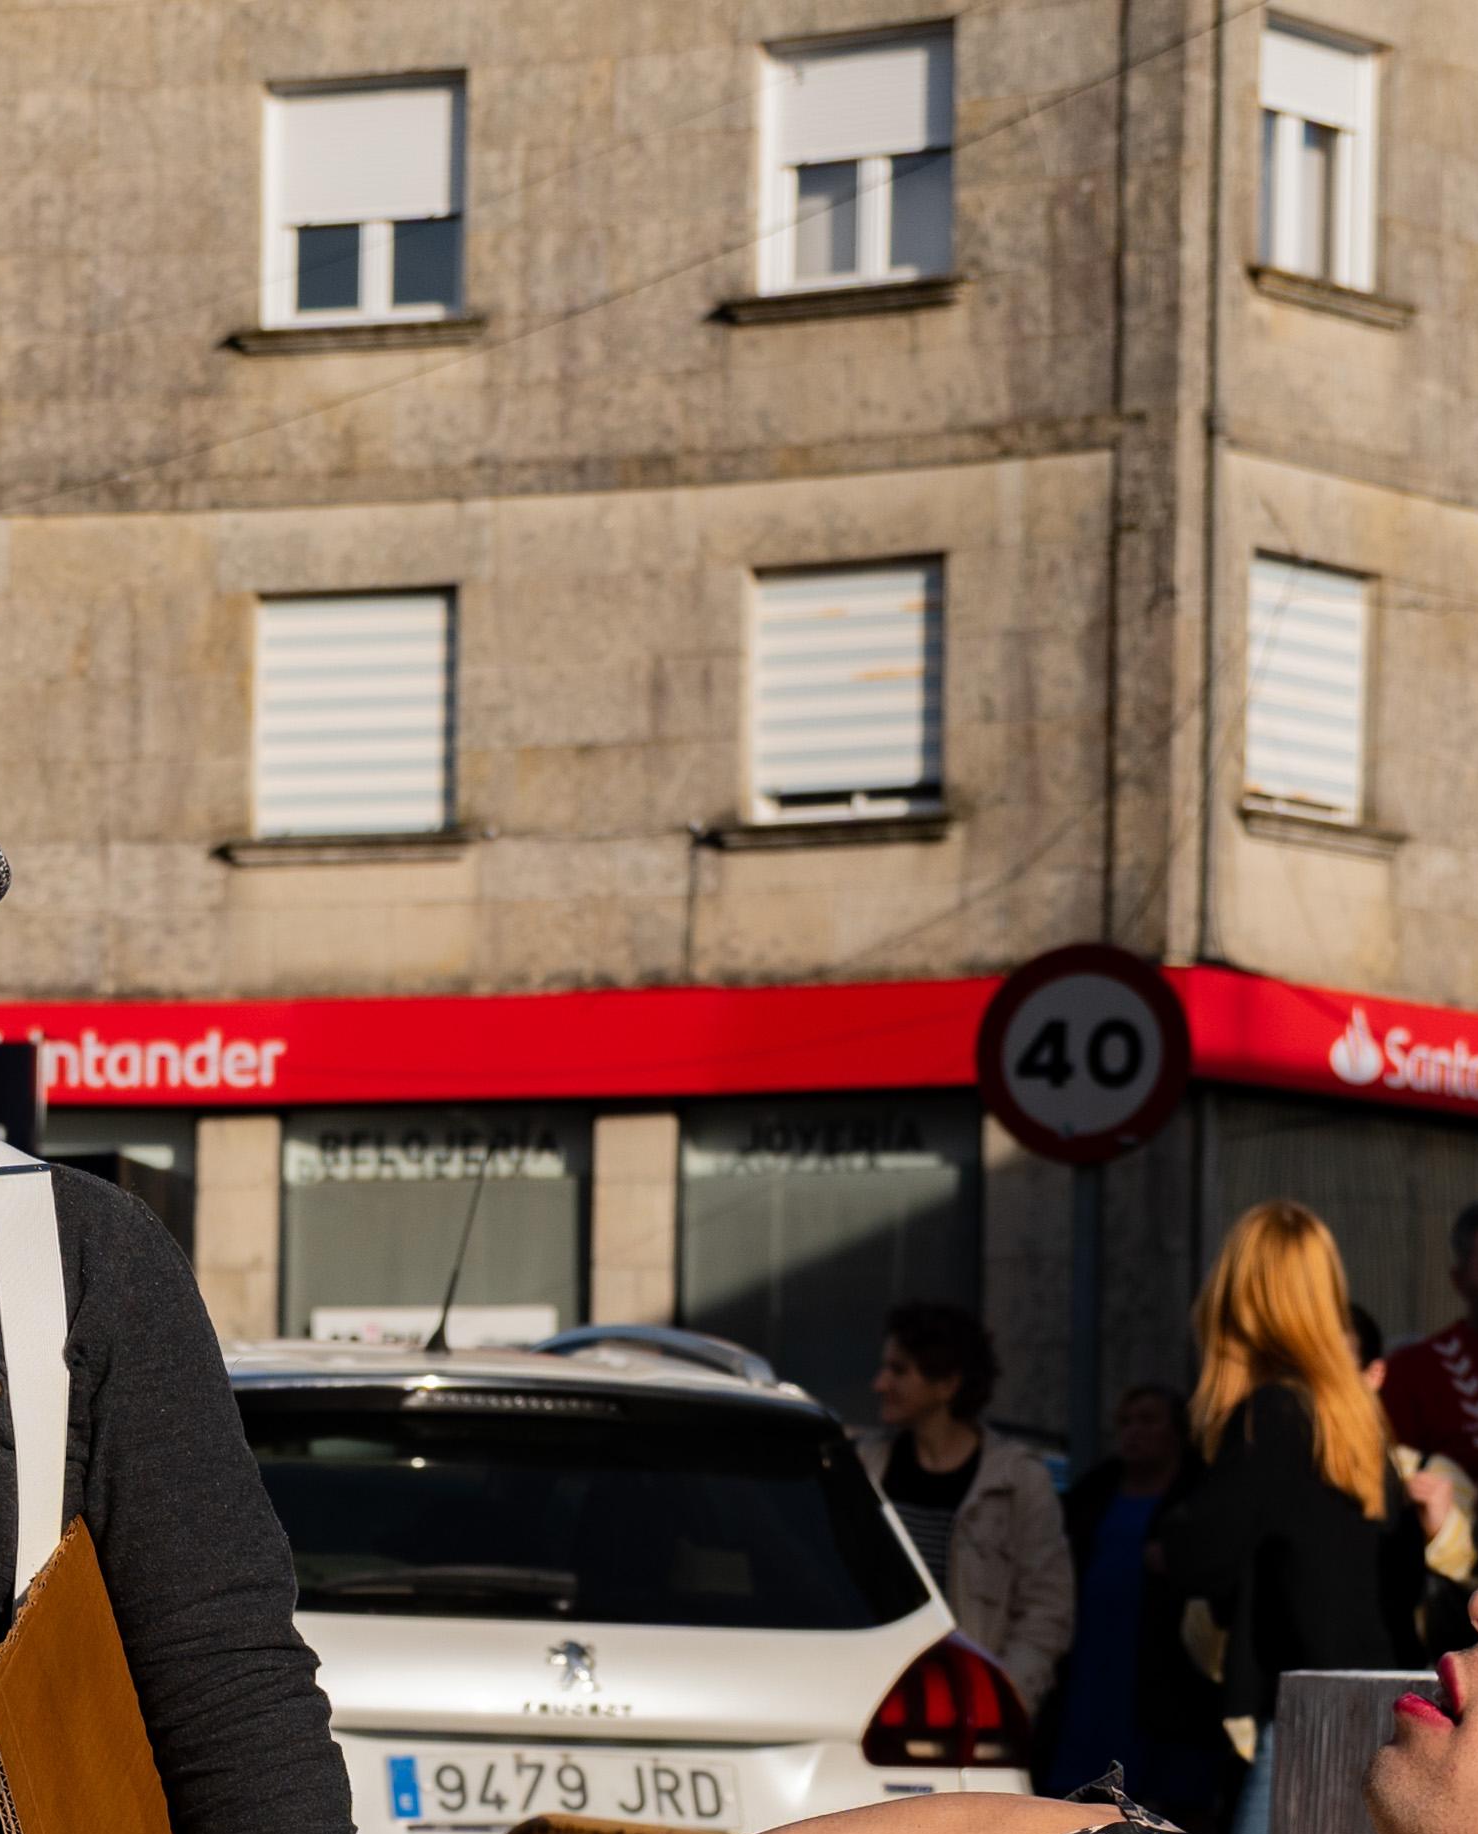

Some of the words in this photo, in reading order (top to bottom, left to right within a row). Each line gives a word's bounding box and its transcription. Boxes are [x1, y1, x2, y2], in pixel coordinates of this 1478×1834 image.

[1015, 1018, 1143, 1090] 40
[434, 1763, 589, 1813] 9479
[619, 1766, 724, 1818] JRD
